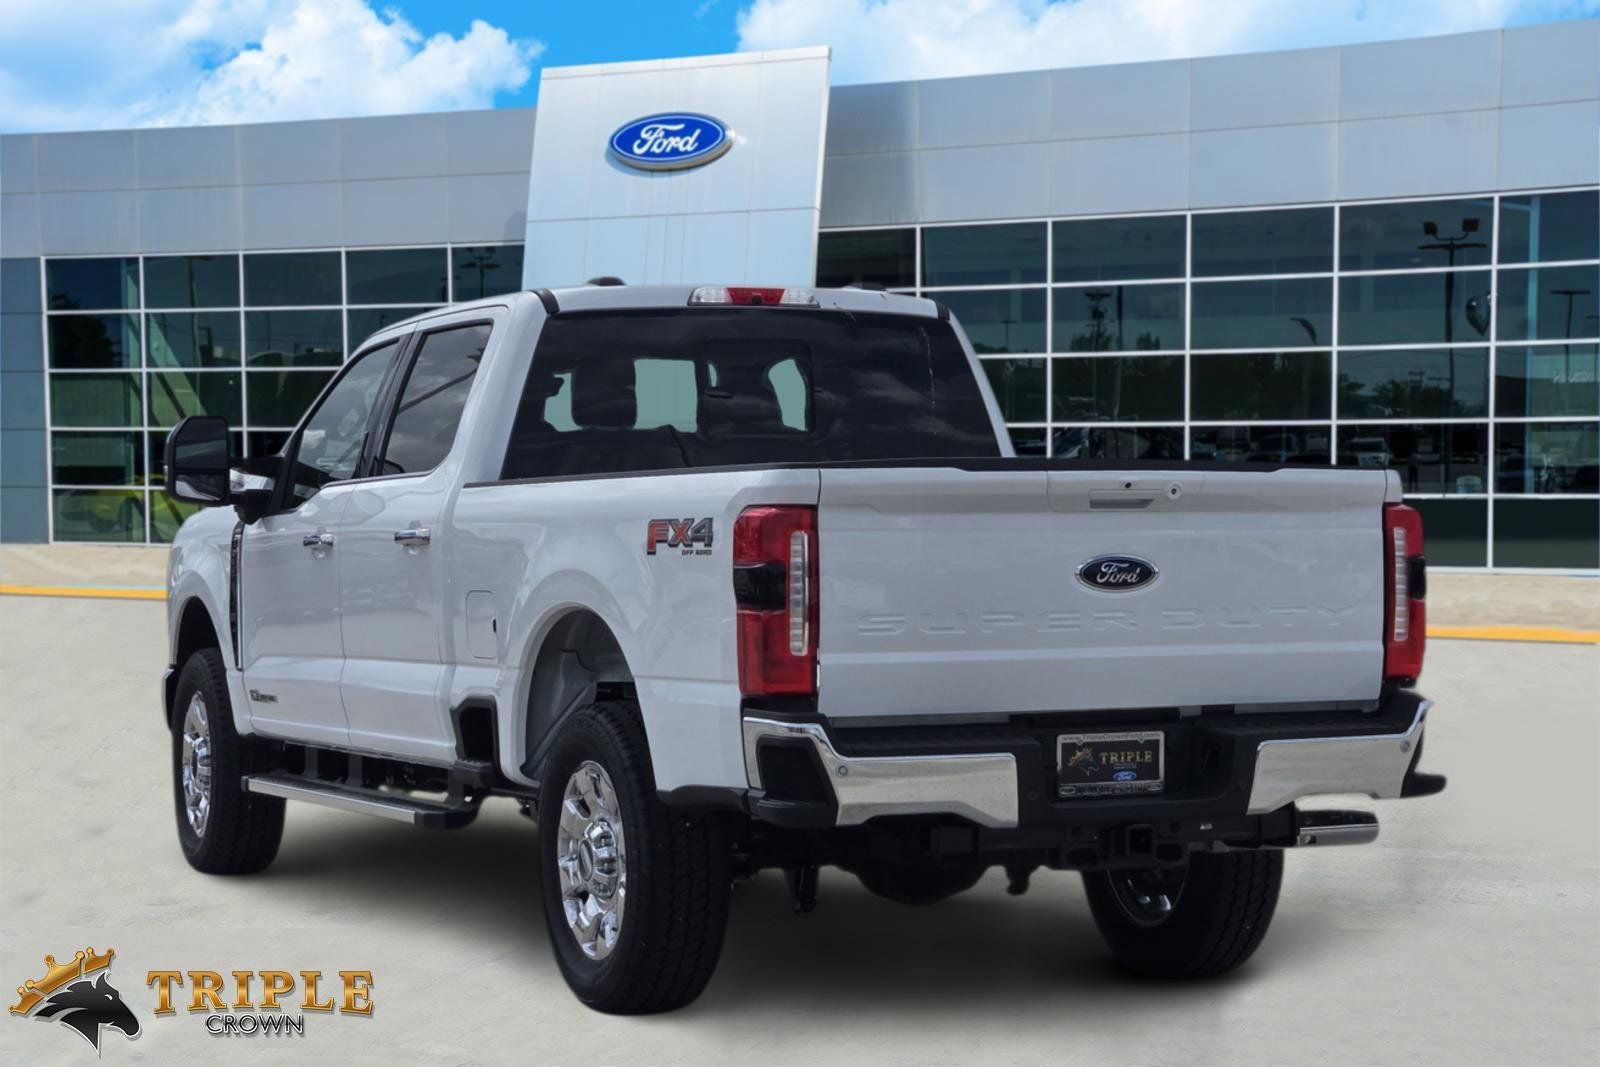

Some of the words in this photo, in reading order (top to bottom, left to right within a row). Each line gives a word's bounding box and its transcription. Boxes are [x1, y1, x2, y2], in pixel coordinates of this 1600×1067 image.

[632, 123, 702, 155] Ford
[647, 517, 714, 555] FX4
[1096, 561, 1141, 583] Ford
[857, 609, 1139, 637] SUPER
[1159, 604, 1359, 631] DUTY
[1100, 751, 1152, 764] TRIPLE
